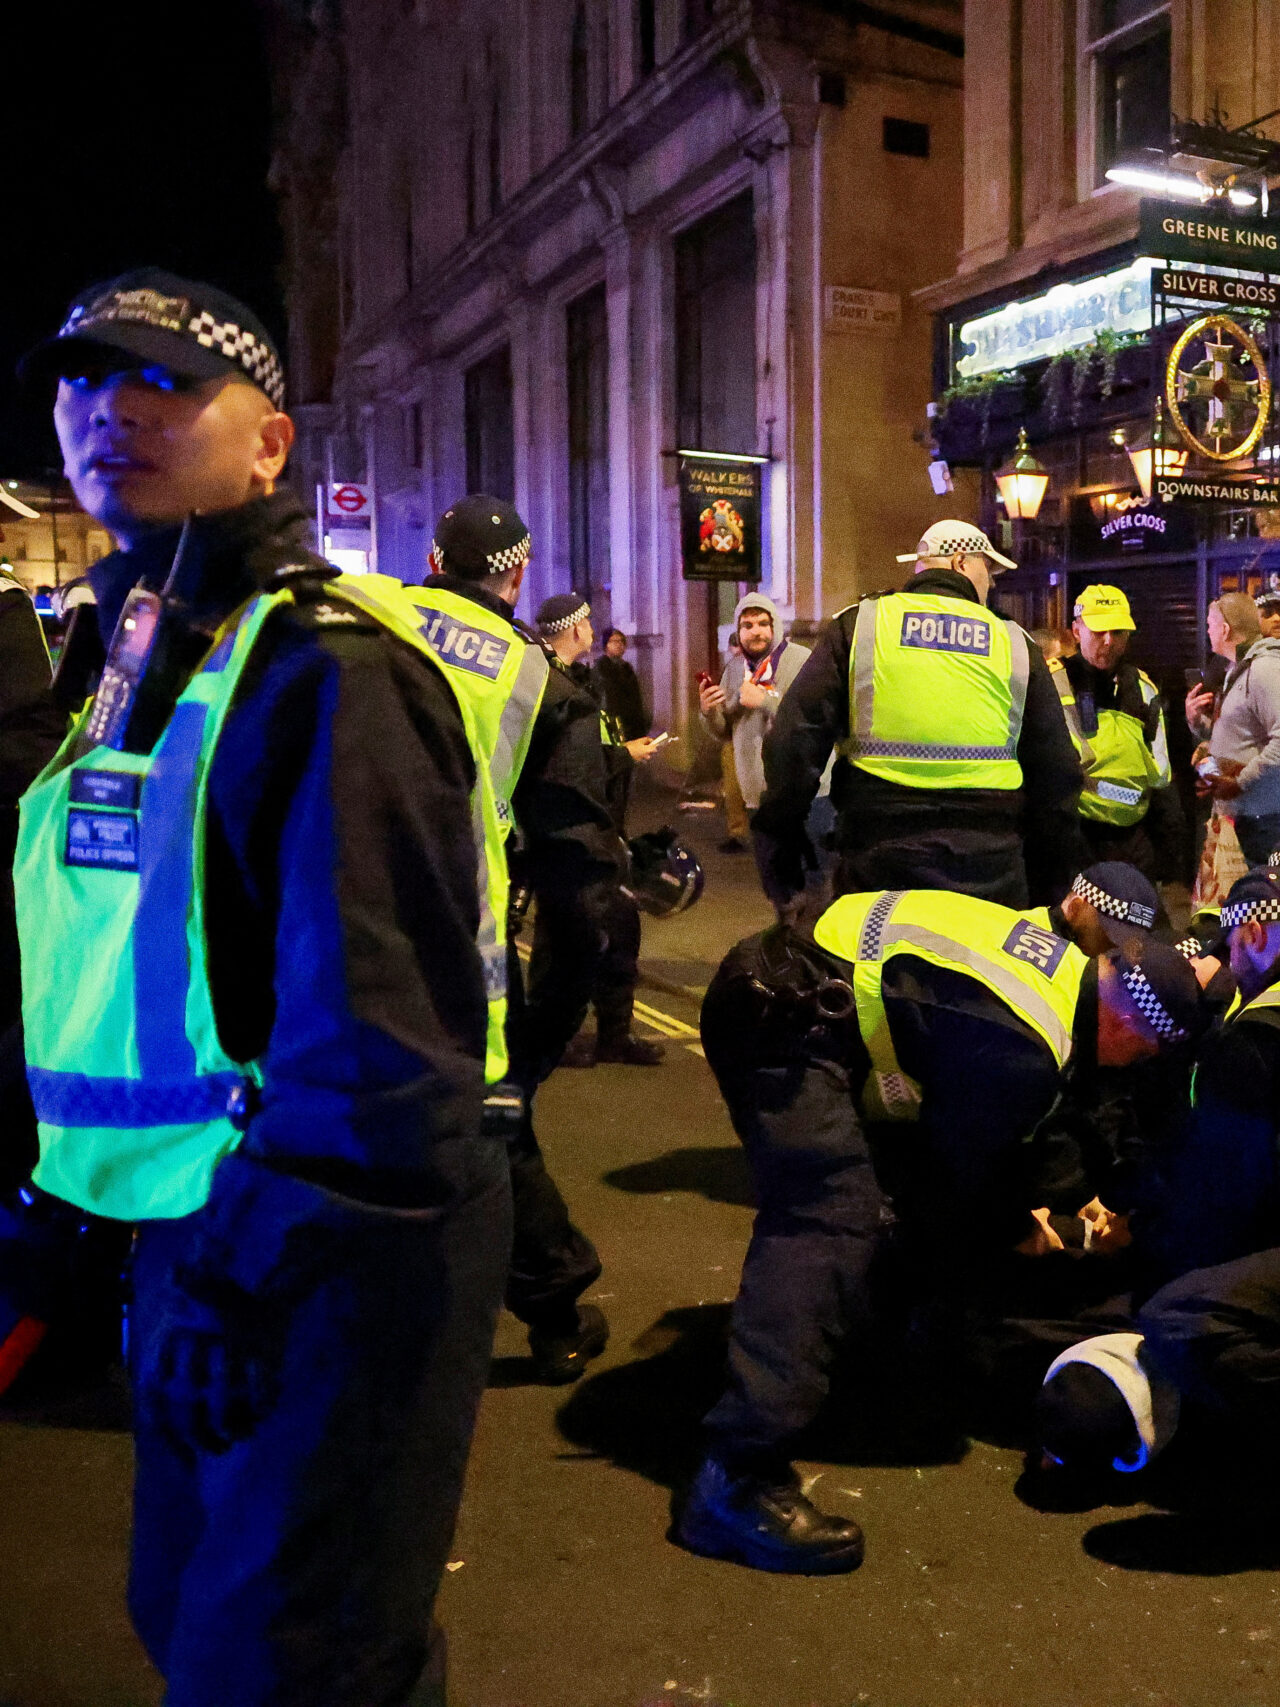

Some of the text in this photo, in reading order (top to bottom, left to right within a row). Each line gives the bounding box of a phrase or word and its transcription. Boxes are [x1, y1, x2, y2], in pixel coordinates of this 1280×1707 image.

[1162, 217, 1230, 243] GREENE
[1235, 229, 1278, 250] KING
[1162, 273, 1277, 304] SILVER CROSS
[688, 469, 755, 486] WALKERS
[1157, 481, 1279, 503] DOWNSTAIRS BAR
[1101, 515, 1133, 540] SILVER
[1133, 513, 1167, 533] CROSS
[420, 614, 502, 669] LICE
[904, 616, 986, 649] POLICE
[1012, 924, 1060, 968] LICE
